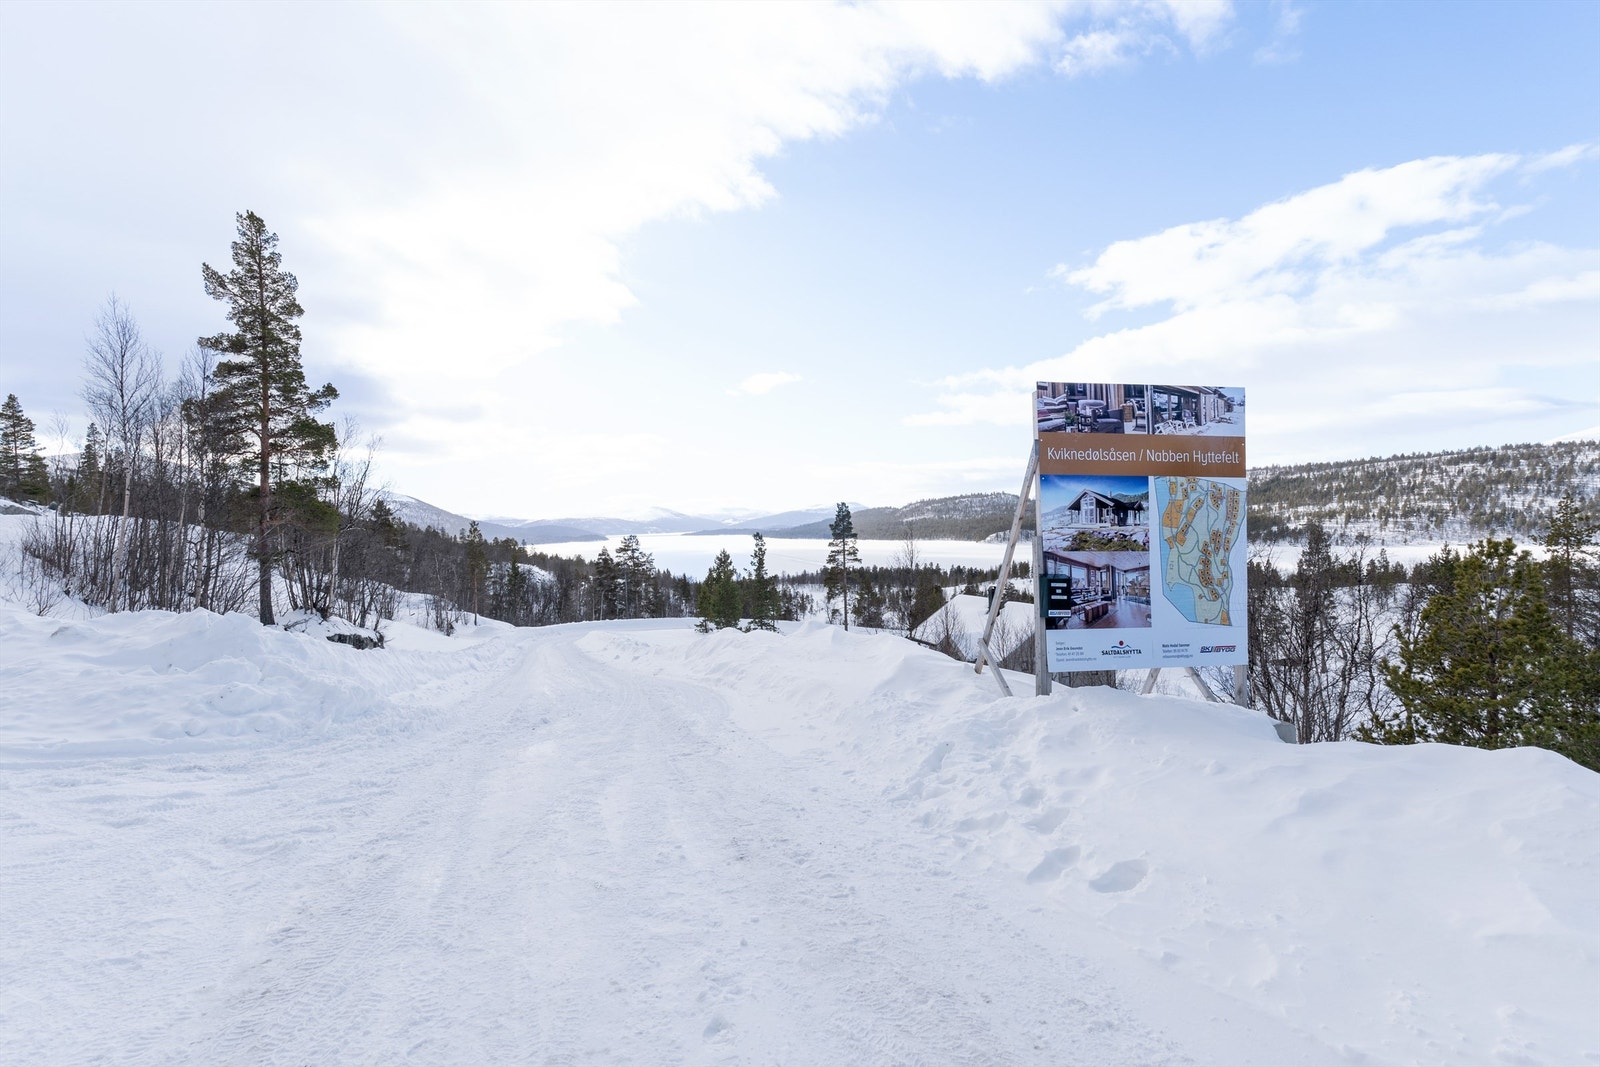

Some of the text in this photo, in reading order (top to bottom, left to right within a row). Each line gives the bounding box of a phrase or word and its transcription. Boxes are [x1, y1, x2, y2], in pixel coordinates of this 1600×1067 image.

[1047, 447, 1240, 465] Kviknedølsåsen / Nabben Hyttefelt
